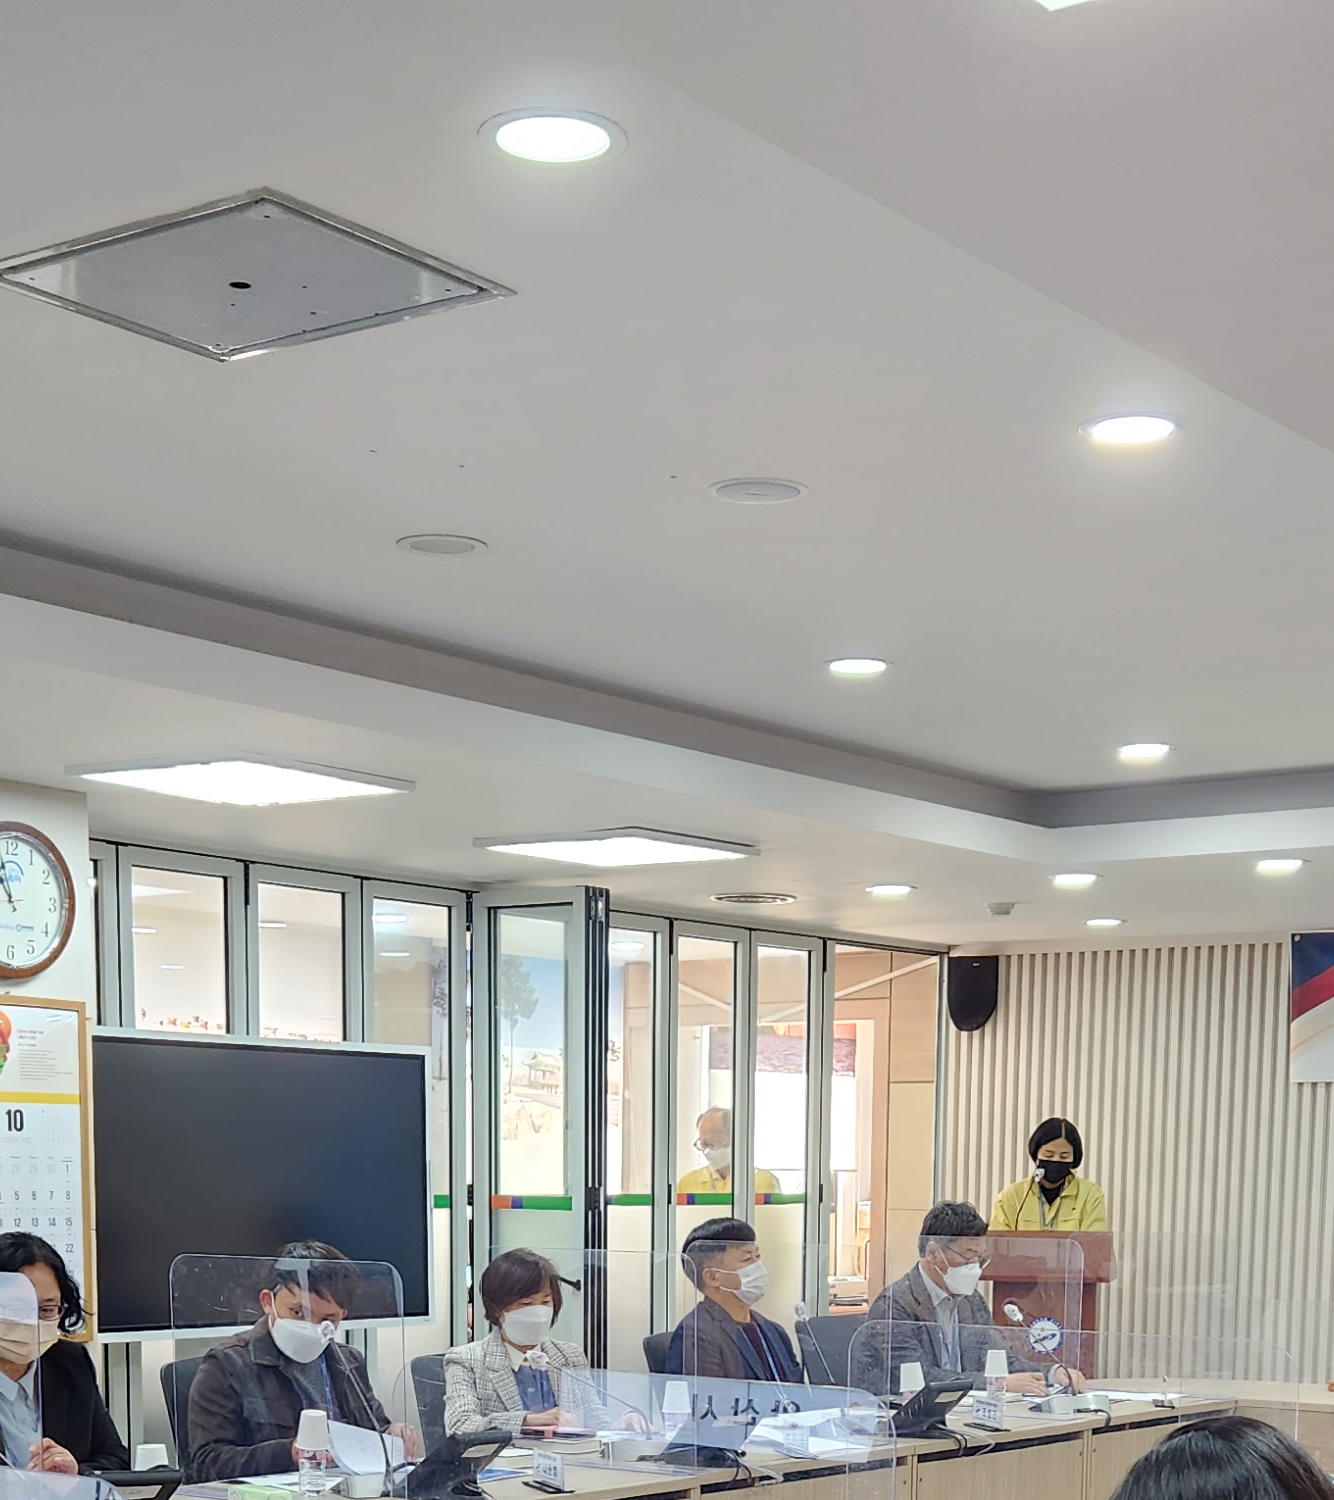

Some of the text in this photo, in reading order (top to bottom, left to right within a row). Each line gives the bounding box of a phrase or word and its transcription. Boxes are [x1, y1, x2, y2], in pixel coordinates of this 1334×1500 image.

[5, 841, 19, 856] 12
[28, 849, 34, 866] 1
[42, 869, 50, 885] 2
[48, 897, 57, 913] 3
[41, 921, 50, 937] 4
[6, 945, 15, 961] 6
[27, 940, 35, 955] 5
[5, 1109, 24, 1132] 10
[11, 1164, 21, 1174] 28
[14, 1191, 20, 1201] 5
[31, 1191, 37, 1201] 6
[49, 1190, 54, 1200] 7
[13, 1218, 22, 1228] 12
[31, 1218, 39, 1228] 13
[48, 1217, 56, 1227] 14
[65, 1217, 73, 1227] 15
[65, 1243, 74, 1253] 22
